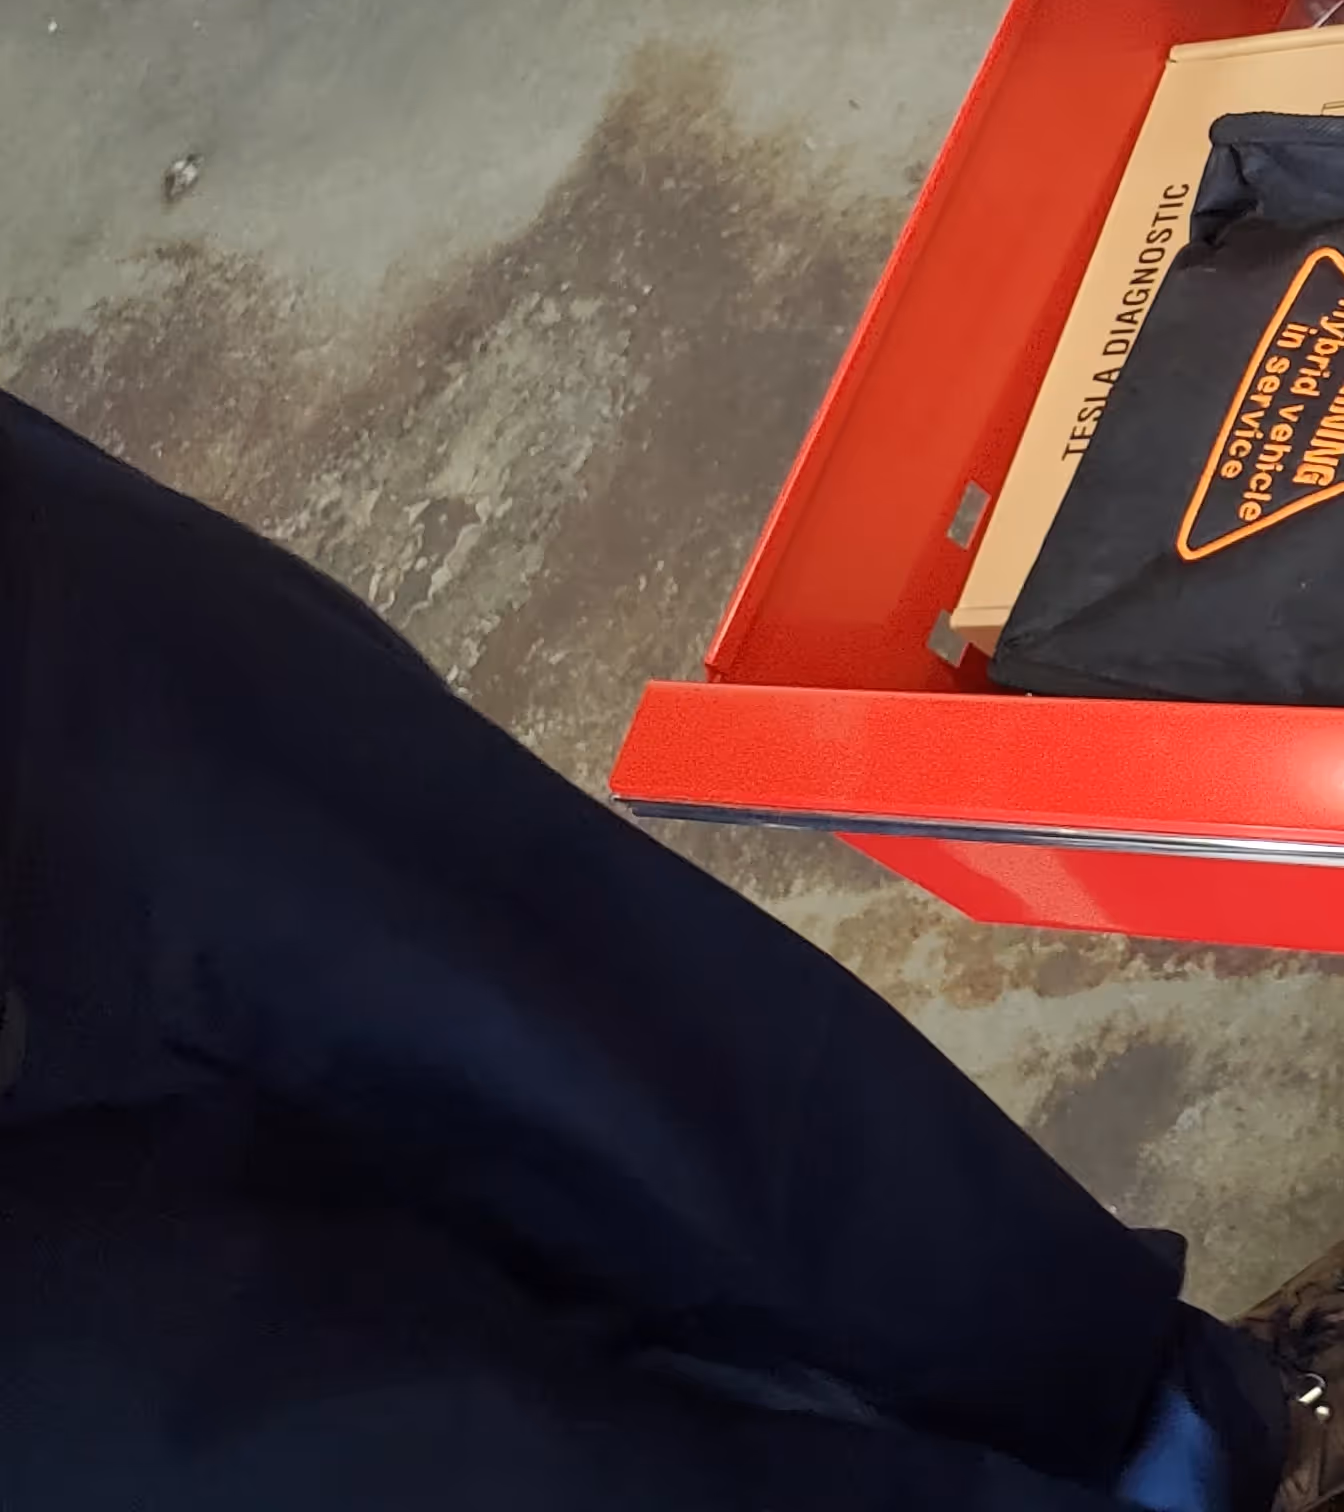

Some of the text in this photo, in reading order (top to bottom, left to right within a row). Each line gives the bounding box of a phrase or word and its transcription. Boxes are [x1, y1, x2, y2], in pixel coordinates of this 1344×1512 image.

[1101, 183, 1191, 357] DIAGNOSTIC
[1220, 322, 1319, 479] in service
[1238, 404, 1305, 522] vehicle
